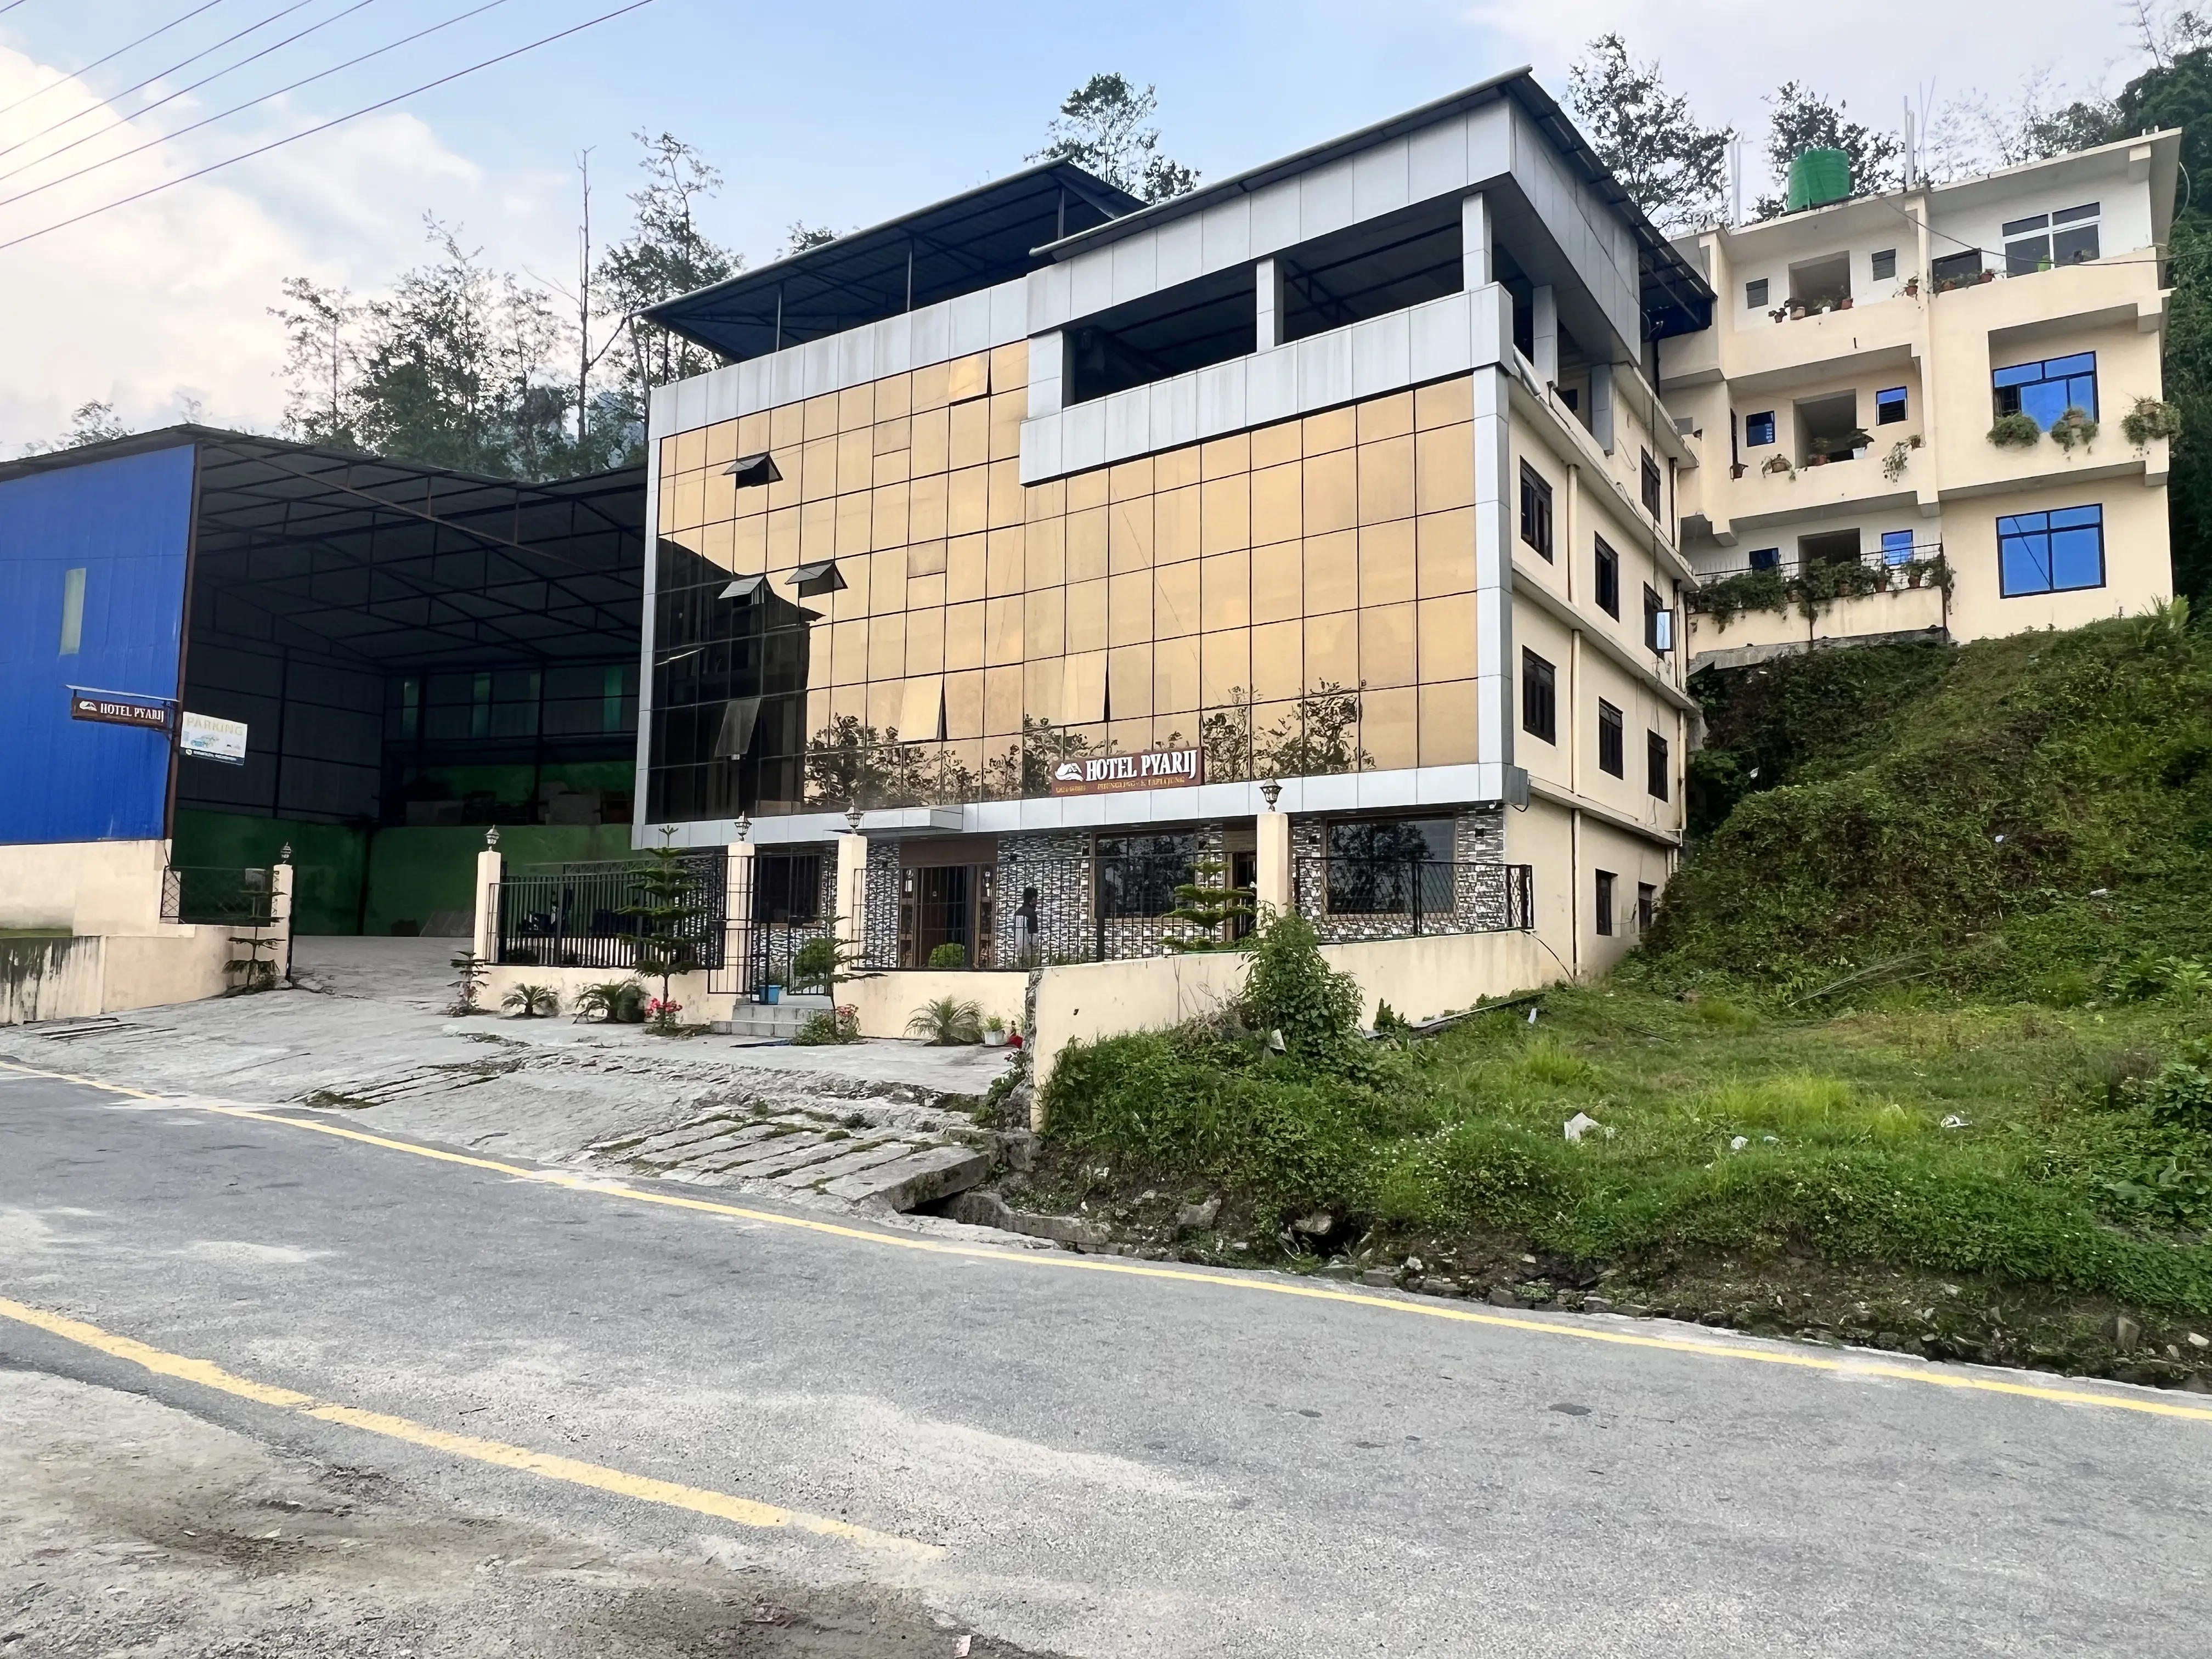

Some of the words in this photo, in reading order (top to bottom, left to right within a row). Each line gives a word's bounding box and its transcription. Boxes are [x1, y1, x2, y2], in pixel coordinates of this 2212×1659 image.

[100, 703, 132, 716] HOTEL
[187, 718, 242, 736] PARKING
[1085, 756, 1137, 781] HOTEL
[1140, 749, 1198, 779] PYARIJ
